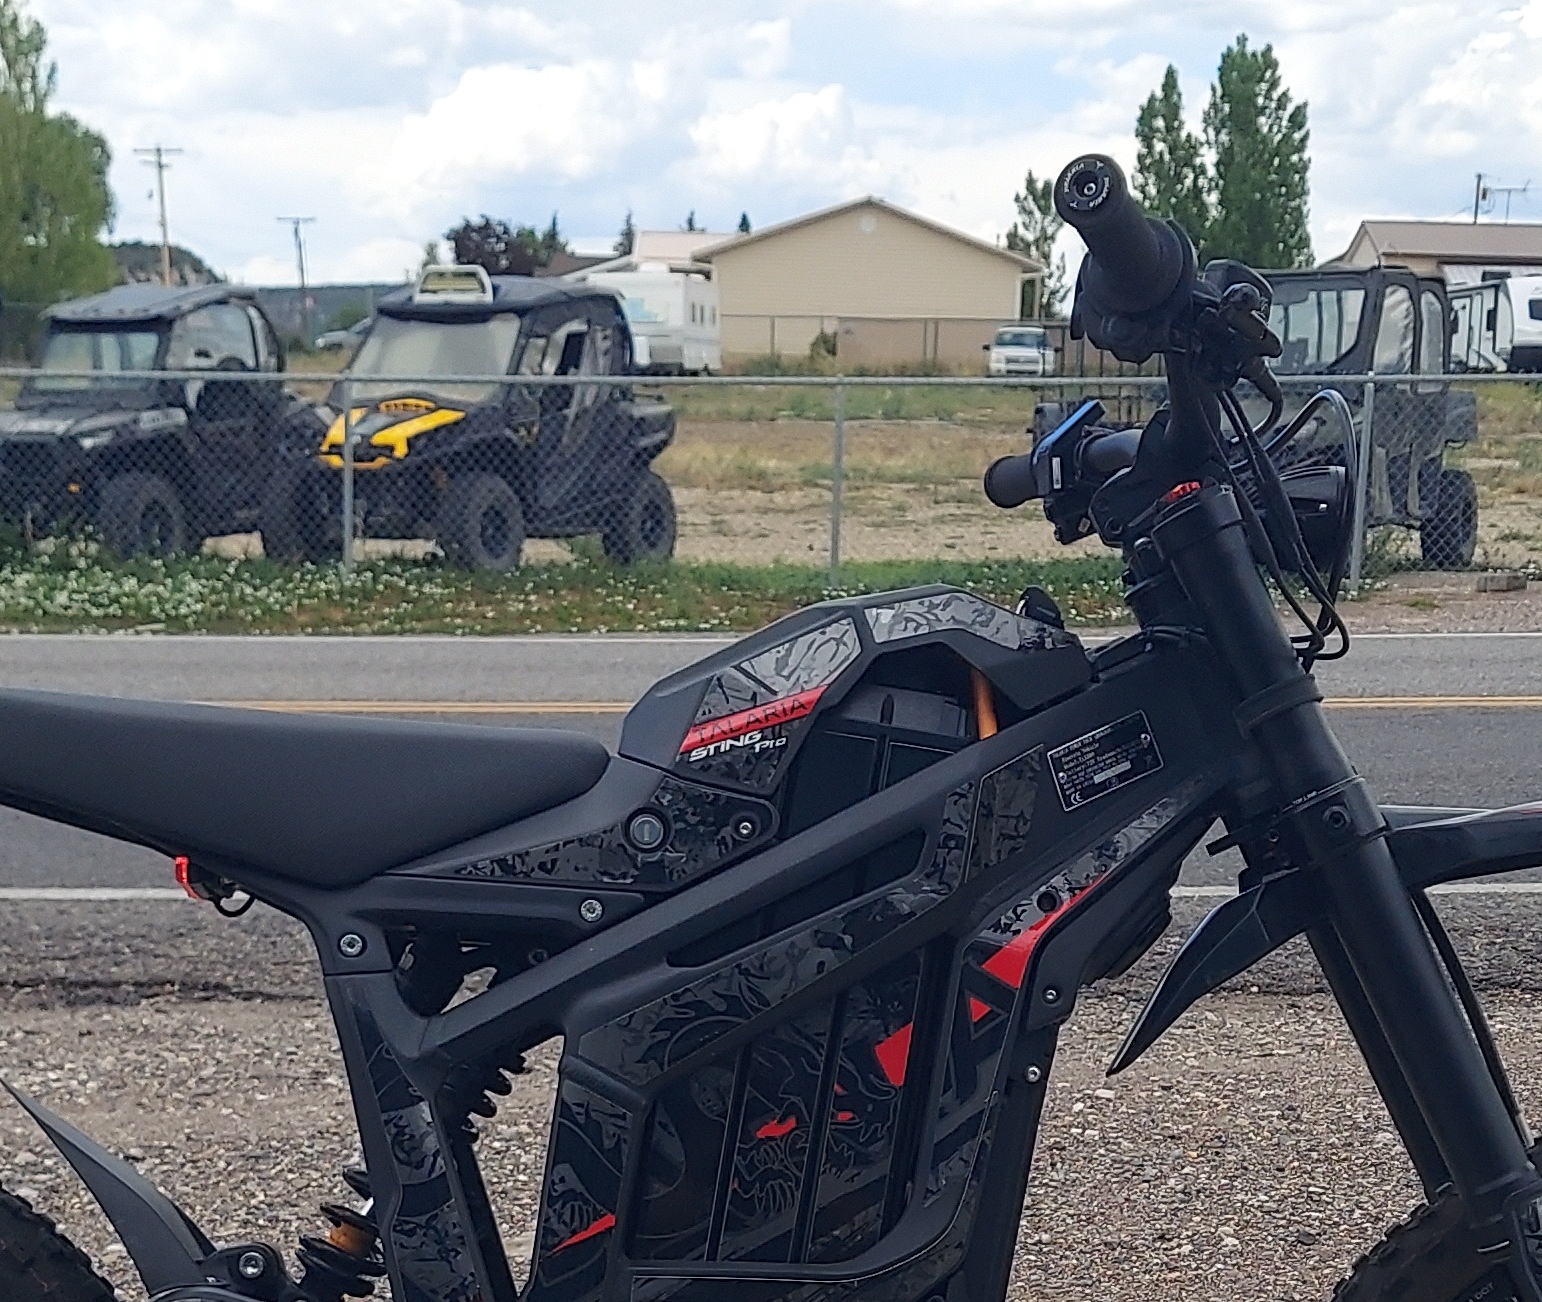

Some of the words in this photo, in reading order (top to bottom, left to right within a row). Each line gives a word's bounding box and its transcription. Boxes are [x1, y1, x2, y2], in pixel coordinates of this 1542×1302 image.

[695, 697, 808, 743] TALARIA
[689, 730, 763, 762] STING
[1474, 1282, 1495, 1300] DOT
